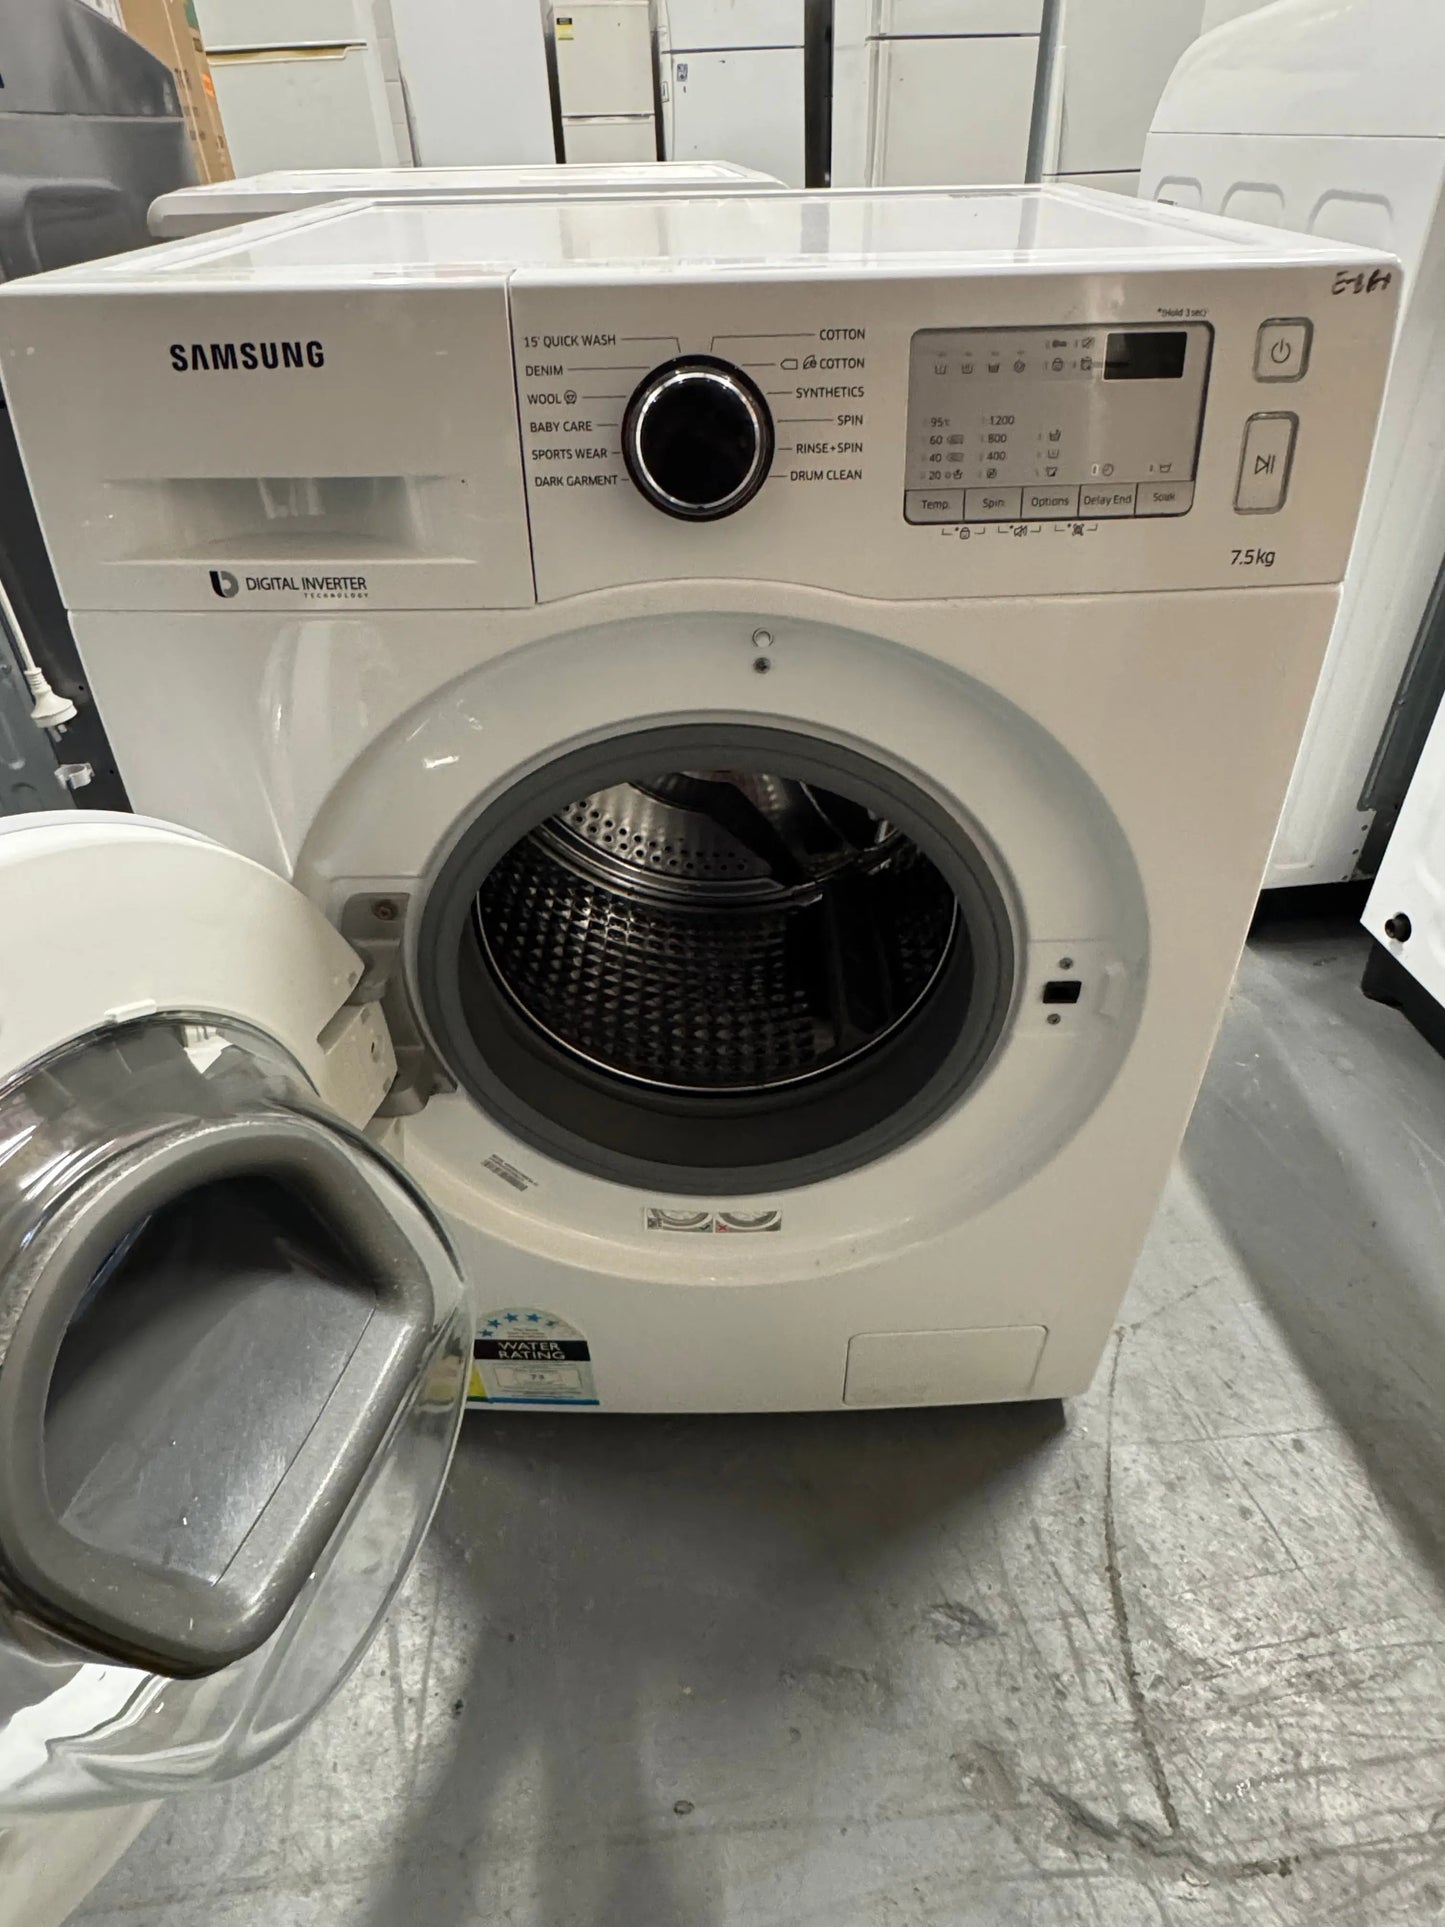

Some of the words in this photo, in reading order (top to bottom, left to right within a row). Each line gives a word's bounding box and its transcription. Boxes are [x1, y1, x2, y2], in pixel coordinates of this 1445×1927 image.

[819, 328, 865, 341] COTTON
[543, 336, 579, 348] QUICK
[581, 335, 616, 347] WASH
[169, 340, 325, 372] SAMSUNG
[819, 357, 865, 370] COTTON
[525, 364, 563, 376] DENIM
[795, 386, 865, 399] SYNTHETICS
[527, 393, 562, 405] WOOL
[837, 414, 863, 426] SPIN
[989, 415, 1015, 426] 1200
[530, 420, 560, 433] BABY
[563, 420, 592, 432] CARE
[929, 434, 943, 446] 60
[532, 447, 572, 461] SPORTS
[575, 447, 608, 460] WEAR
[796, 441, 863, 455] RINSE+SPIN
[929, 453, 942, 463] 40
[986, 451, 1006, 462] 400
[535, 475, 564, 487] DARK
[566, 474, 618, 487] GARMENT
[790, 469, 824, 481] DRUM
[826, 469, 862, 481] CLEAN
[928, 470, 942, 481] 20
[982, 498, 1005, 509] Spin
[1031, 495, 1069, 508] Options
[1083, 494, 1112, 506] Delay
[1113, 494, 1132, 505] End
[246, 576, 300, 591] DIGITAL
[302, 576, 368, 591] INVERTER
[498, 1342, 561, 1351] WATER
[499, 1351, 566, 1360] RATING
